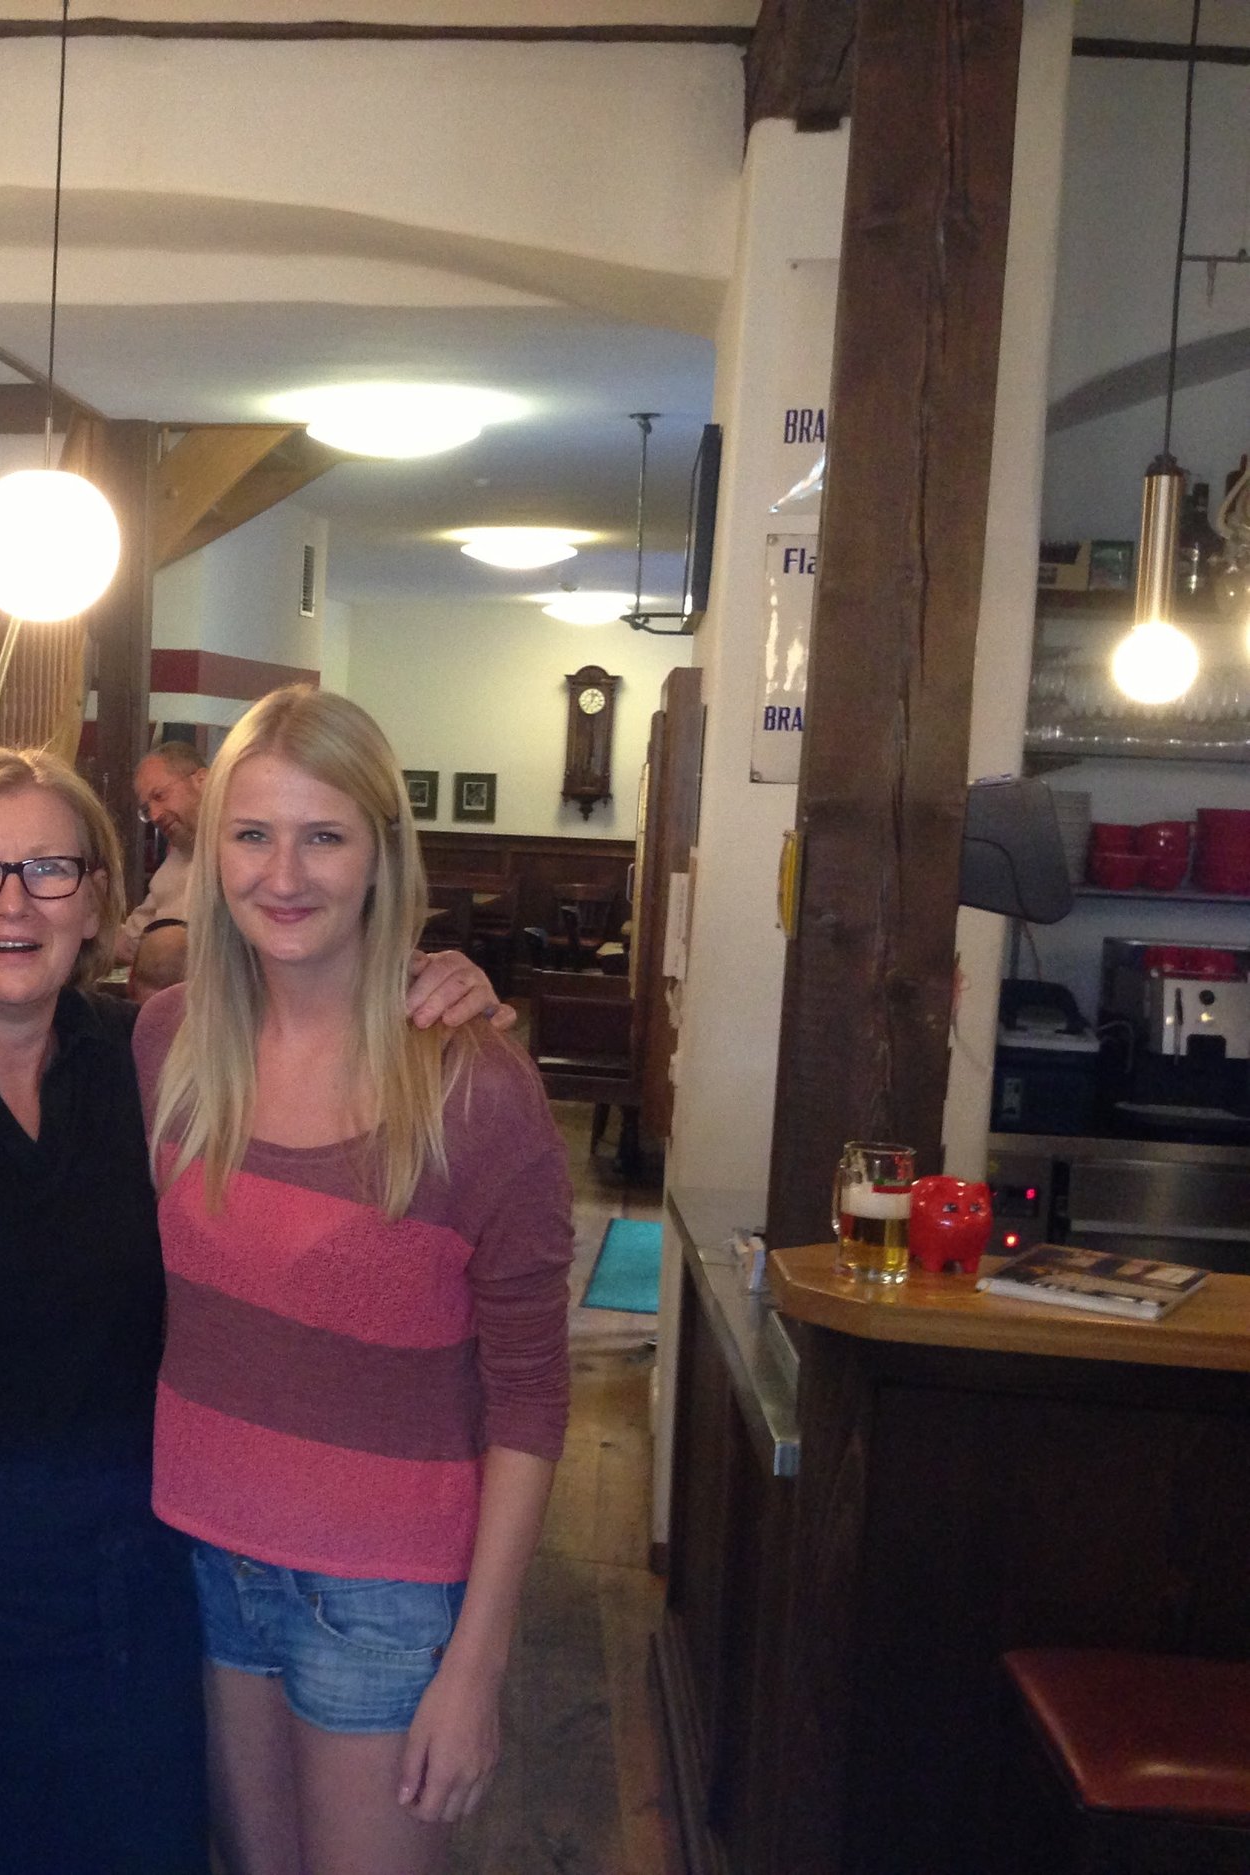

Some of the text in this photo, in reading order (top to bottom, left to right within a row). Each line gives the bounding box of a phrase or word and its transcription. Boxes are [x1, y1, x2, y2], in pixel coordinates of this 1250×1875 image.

[784, 409, 825, 443] BRA
[783, 548, 817, 574] Fla
[764, 706, 804, 731] BRA
